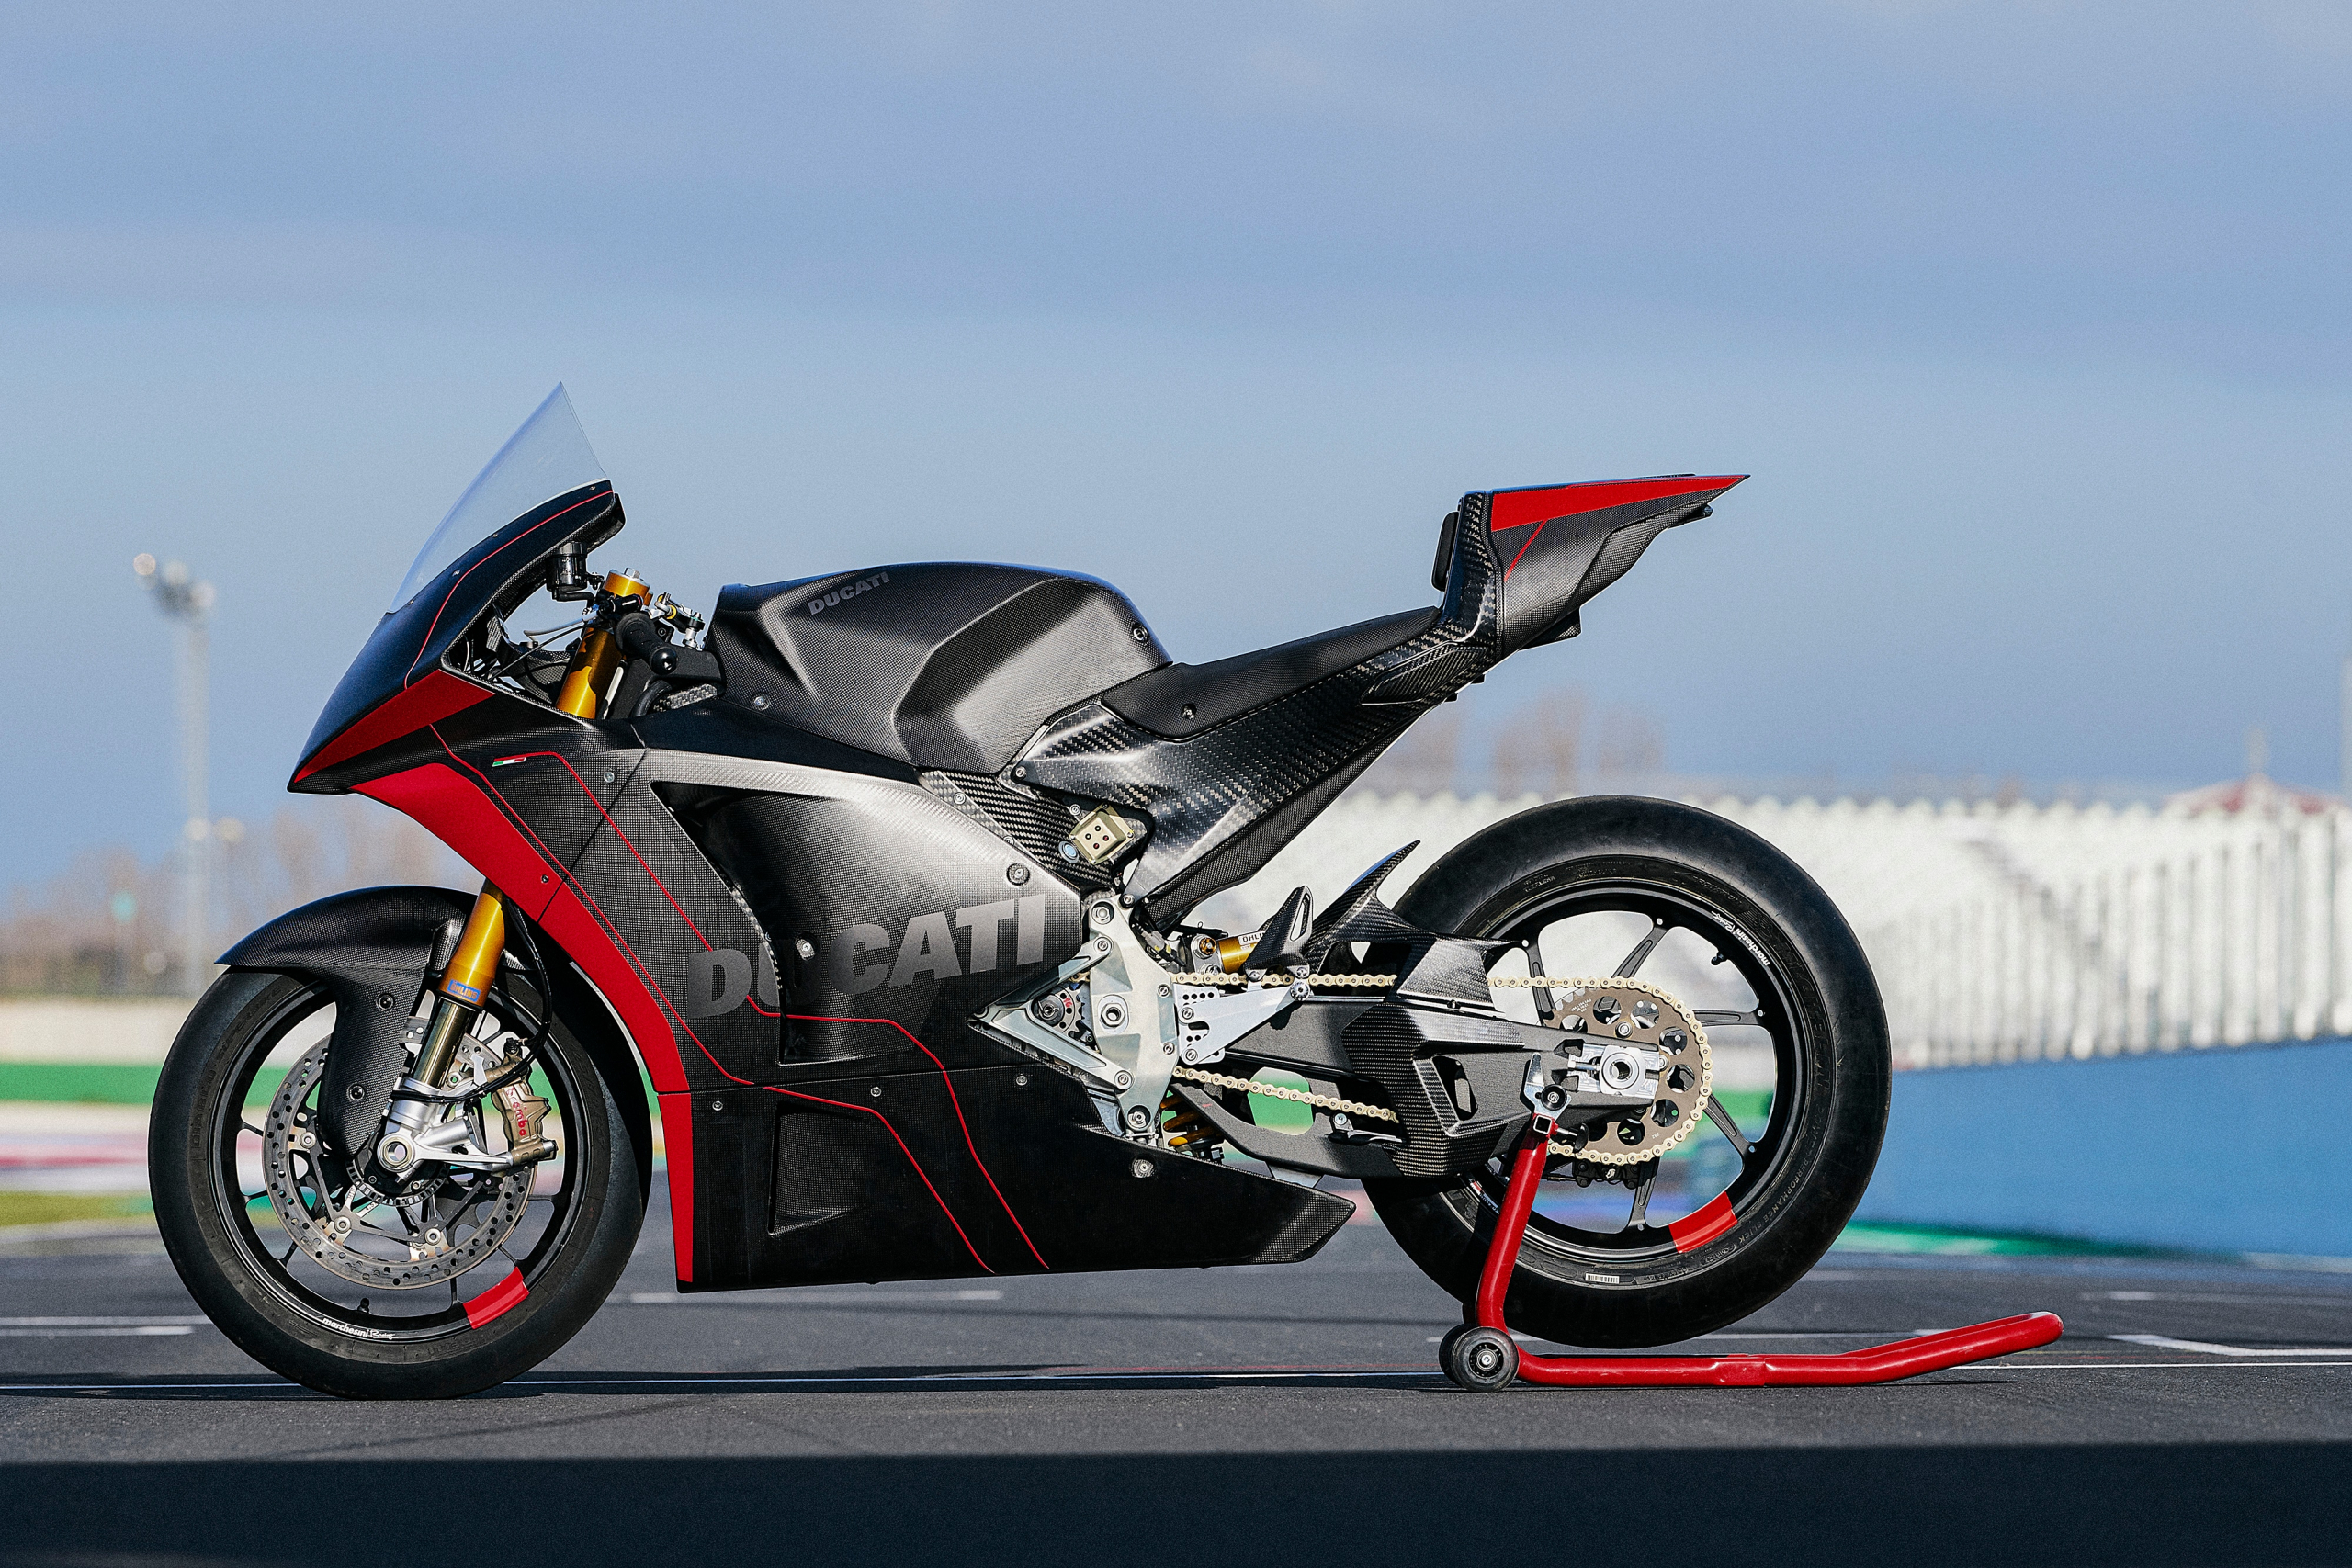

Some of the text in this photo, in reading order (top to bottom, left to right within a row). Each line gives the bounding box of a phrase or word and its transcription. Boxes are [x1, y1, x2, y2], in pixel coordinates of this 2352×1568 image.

[808, 571, 890, 615] DUCATI
[686, 894, 1046, 1020] DUCATI
[1732, 928, 1770, 966] marchesini
[506, 1087, 528, 1136] brembo
[1762, 1158, 1809, 1223] PERFORMANCE
[1738, 1222, 1763, 1245] SLICK
[322, 1317, 370, 1338] marchesini
